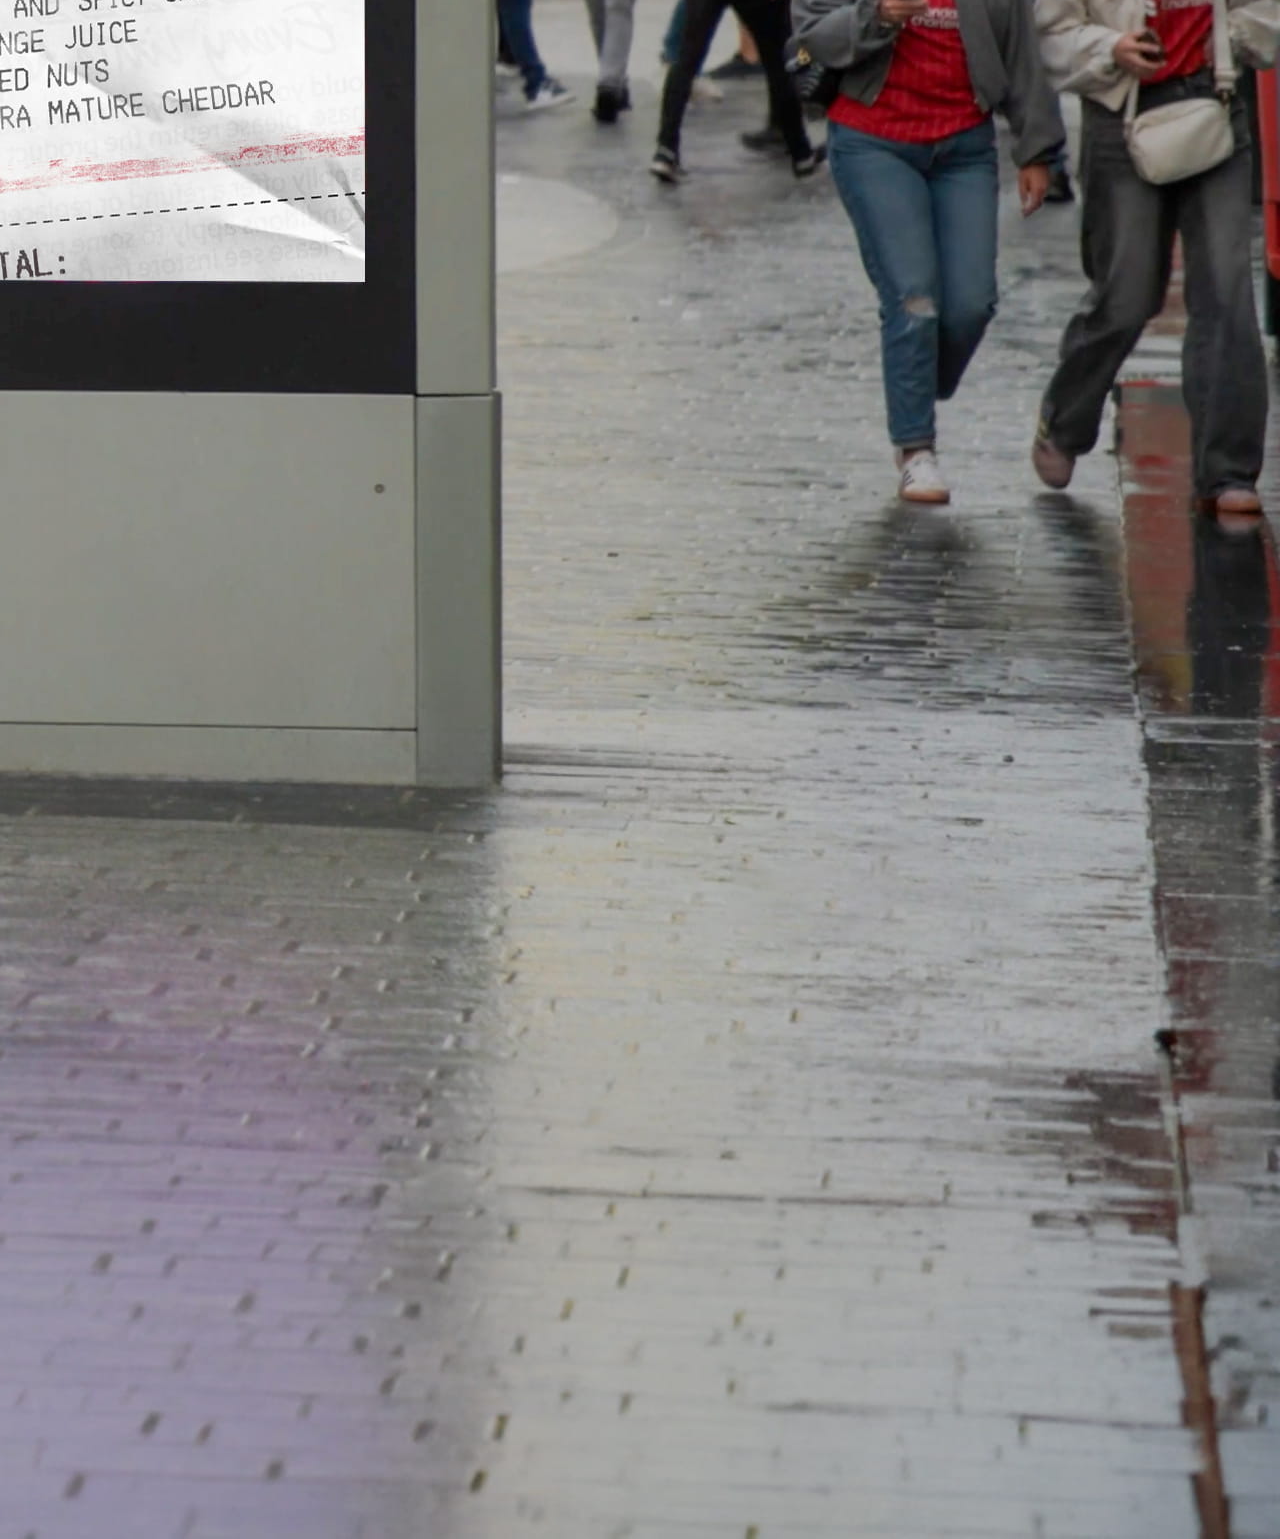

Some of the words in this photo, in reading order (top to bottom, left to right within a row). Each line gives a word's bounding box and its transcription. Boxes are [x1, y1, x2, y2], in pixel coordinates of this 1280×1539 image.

[64, 18, 139, 50] JUICE
[47, 58, 110, 89] NUTS
[47, 92, 146, 126] MATURE
[161, 79, 276, 115] CHEDDAR
